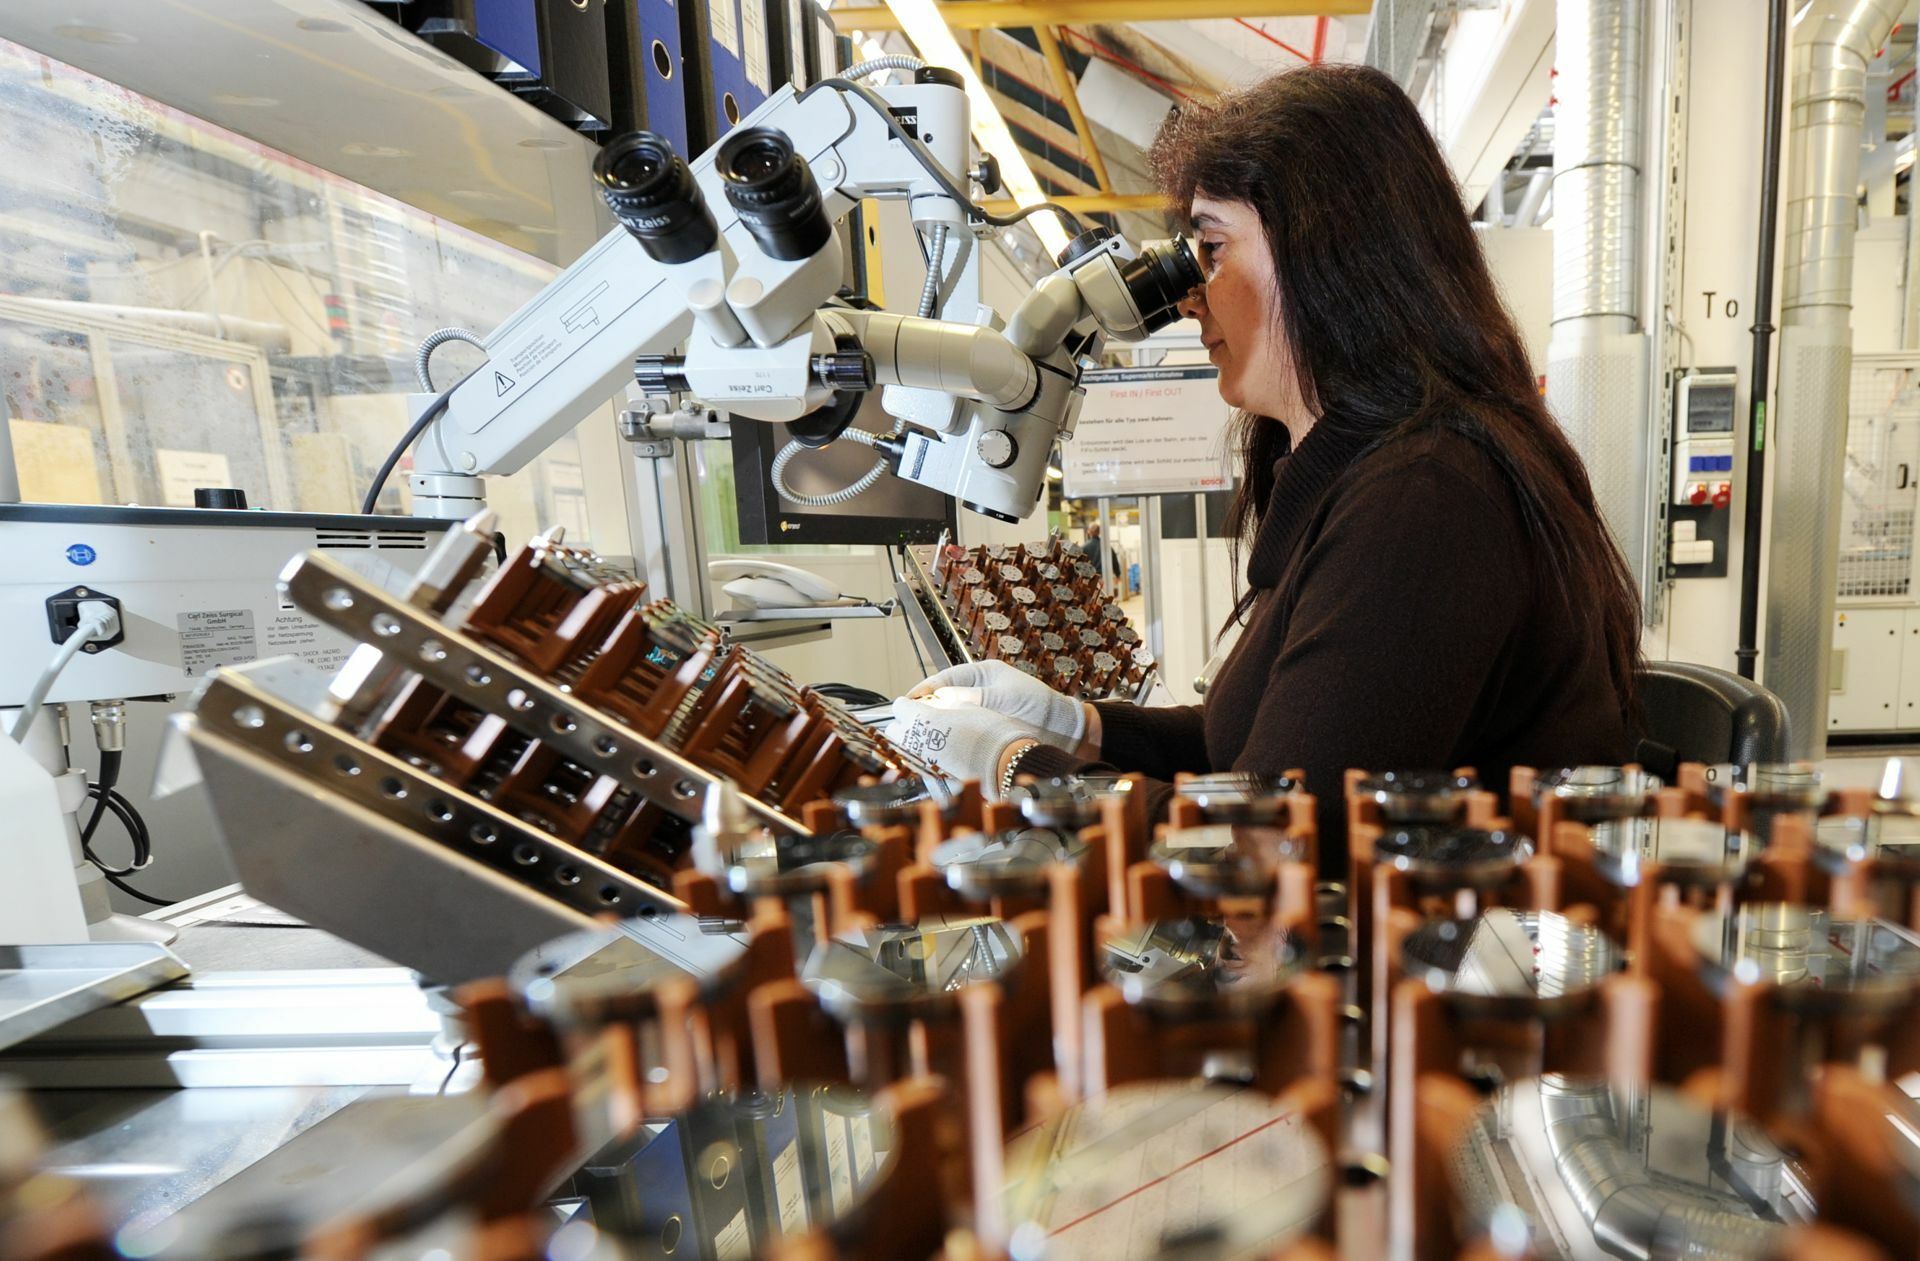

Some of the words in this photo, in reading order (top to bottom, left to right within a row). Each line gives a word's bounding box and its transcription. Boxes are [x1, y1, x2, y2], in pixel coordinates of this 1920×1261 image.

[894, 116, 917, 124] EISS
[638, 214, 671, 229] Zeiss
[728, 384, 752, 394] Zeiss
[754, 384, 773, 394] Carl
[1110, 389, 1129, 398] First
[1129, 389, 1138, 398] IN
[1145, 388, 1162, 397] First
[1164, 387, 1182, 396] OUT
[219, 610, 244, 618] Surgical
[275, 616, 303, 624] Achtung
